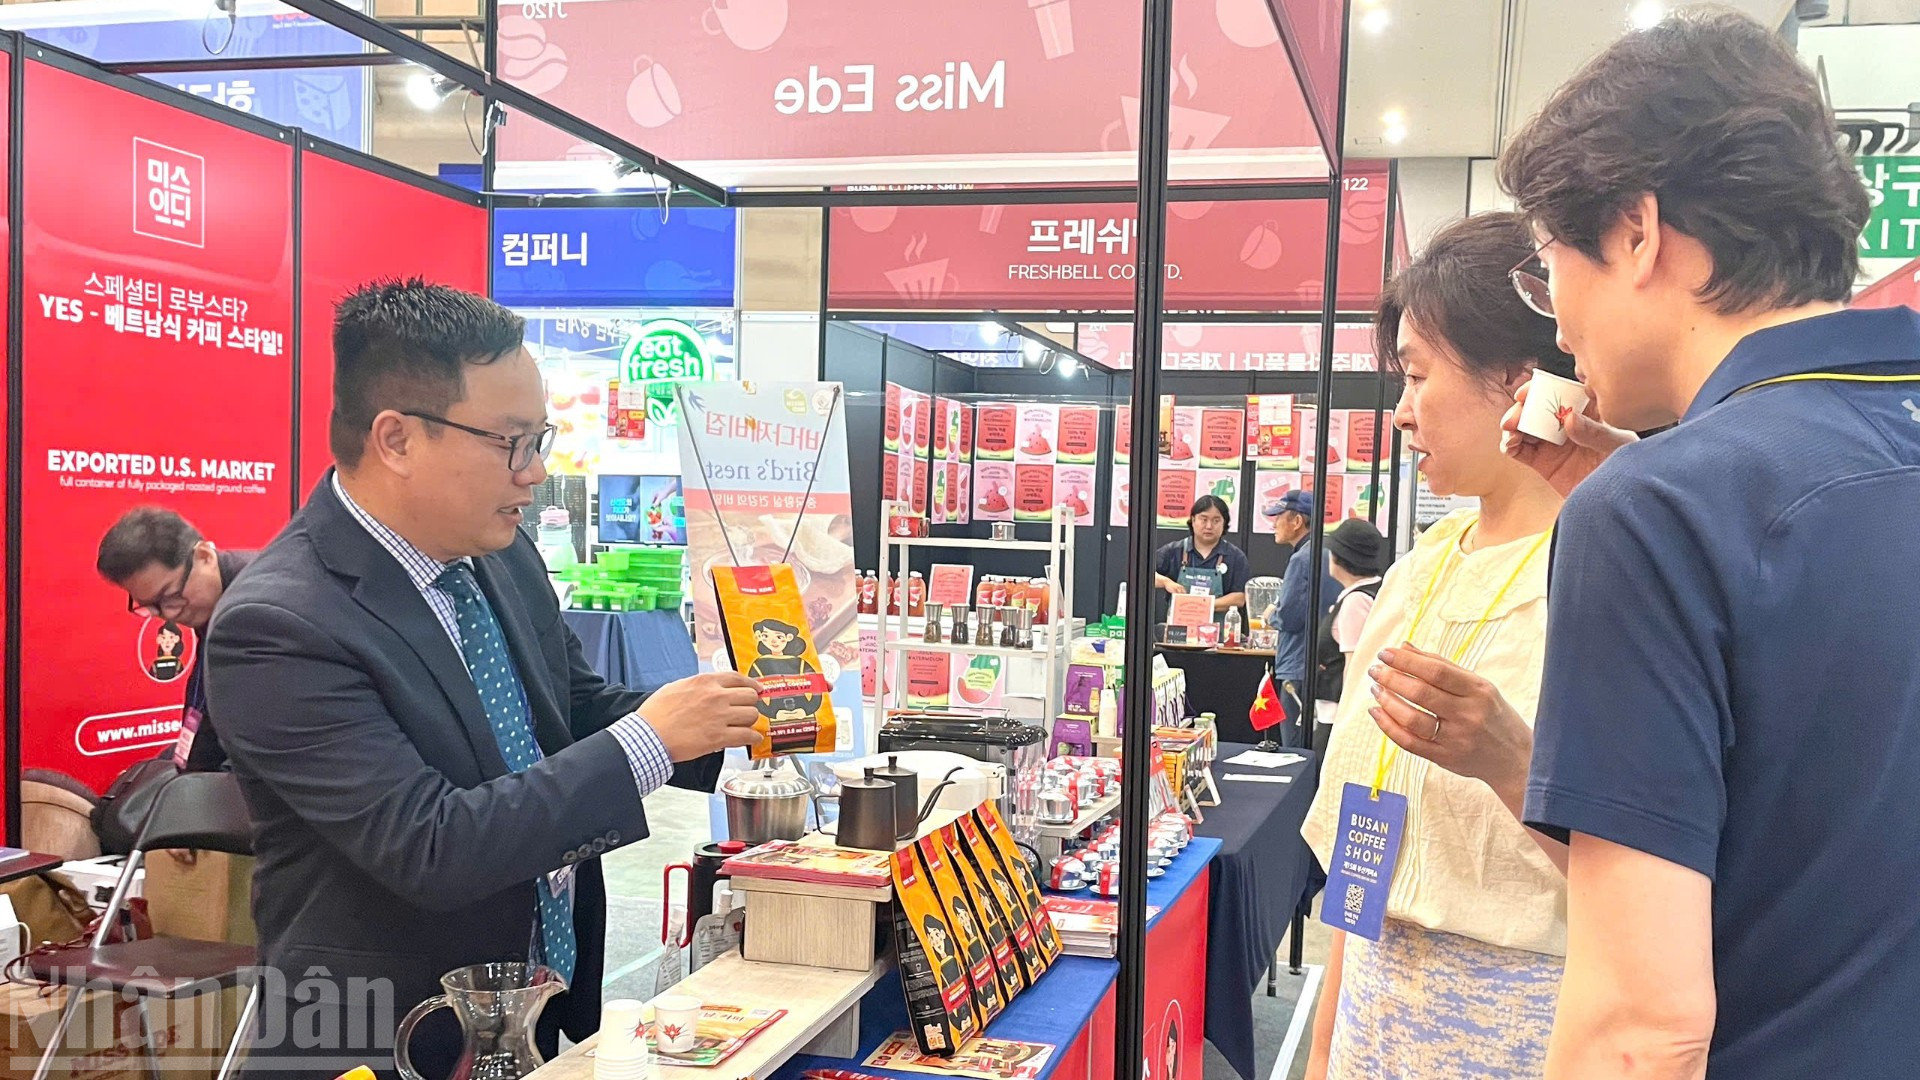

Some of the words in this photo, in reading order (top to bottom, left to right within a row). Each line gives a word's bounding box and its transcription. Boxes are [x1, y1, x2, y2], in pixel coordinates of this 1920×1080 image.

[148, 158, 191, 194] 미스
[1855, 164, 1920, 207] 상구
[502, 233, 588, 267] 컴퍼니
[1027, 218, 1136, 255] 프레쉬
[1008, 264, 1103, 280] FRESHBELL
[84, 272, 162, 309] 스페셜티
[169, 287, 248, 323] 로부스타?
[39, 293, 83, 322] YES
[105, 304, 182, 342] 베트남식
[187, 318, 222, 348] 커피
[227, 325, 283, 356] 스타일!
[640, 334, 684, 358] eat
[629, 352, 700, 380] fresh
[48, 449, 156, 475] EXPORTED
[160, 456, 197, 478] U.S.
[201, 459, 275, 481] MARKET
[1348, 829, 1387, 851] COFFEE
[1351, 813, 1389, 835] BUSAN
[1345, 844, 1383, 866] SHOW
